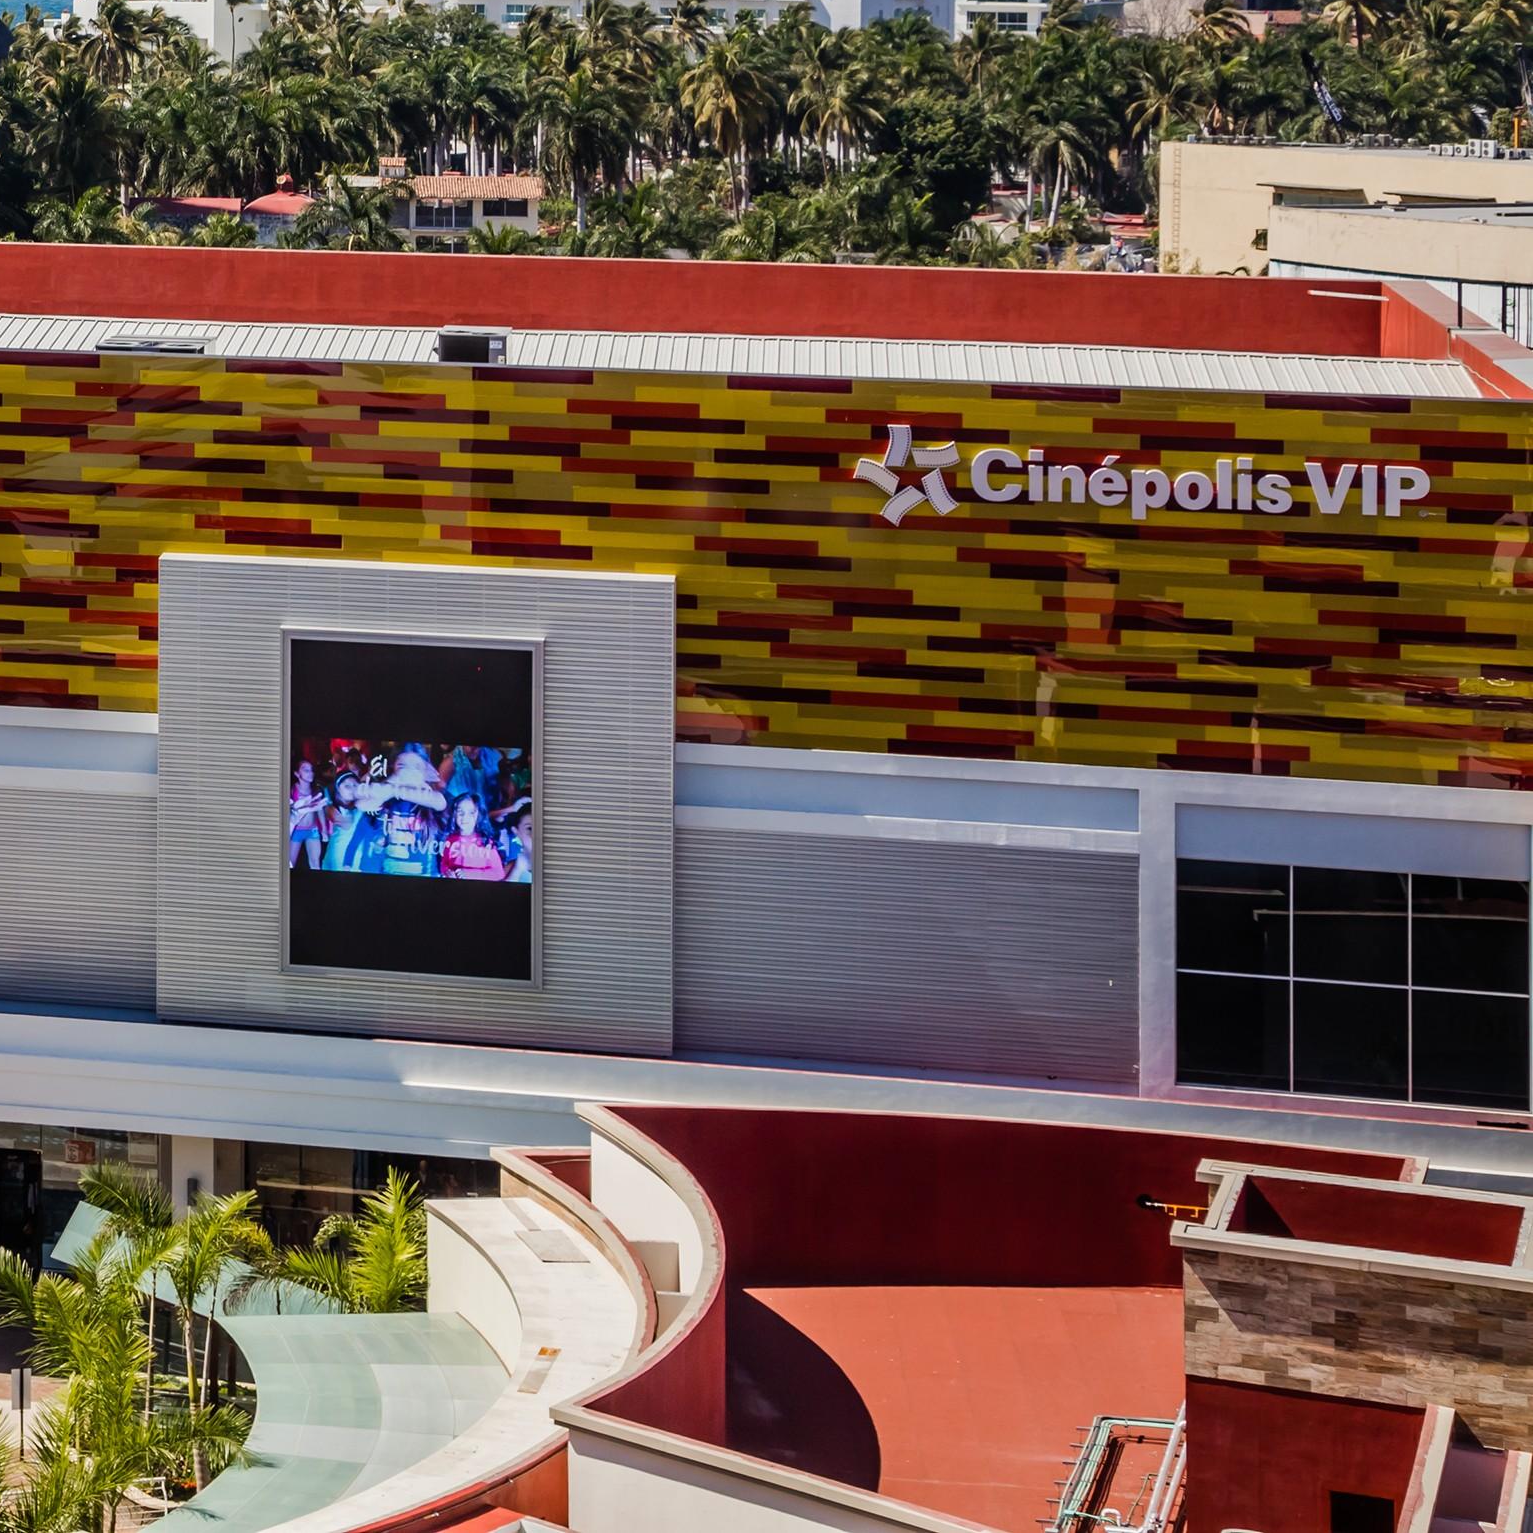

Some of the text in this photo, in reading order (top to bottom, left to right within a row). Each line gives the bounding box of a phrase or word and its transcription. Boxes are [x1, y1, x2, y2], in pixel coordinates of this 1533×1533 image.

[970, 448, 1431, 519] Cinépolis VIP
[370, 754, 388, 777] El
